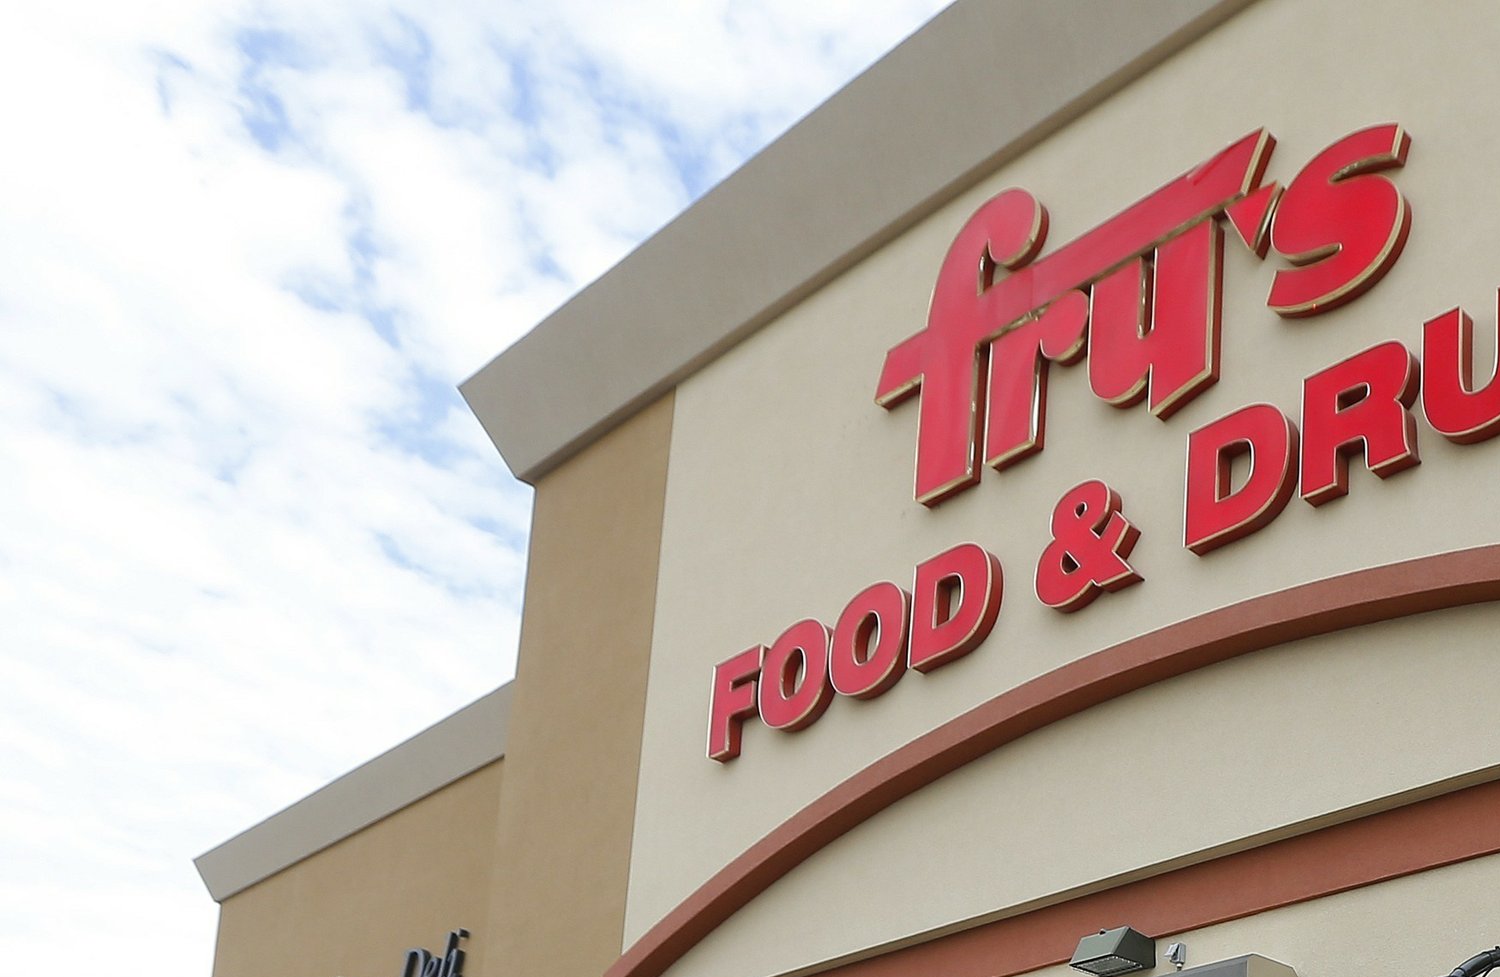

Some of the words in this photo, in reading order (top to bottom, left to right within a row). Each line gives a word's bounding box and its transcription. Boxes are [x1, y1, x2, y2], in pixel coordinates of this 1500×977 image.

[874, 121, 1412, 507] fry's
[706, 541, 1003, 764] FOOD
[1034, 478, 1144, 613] &
